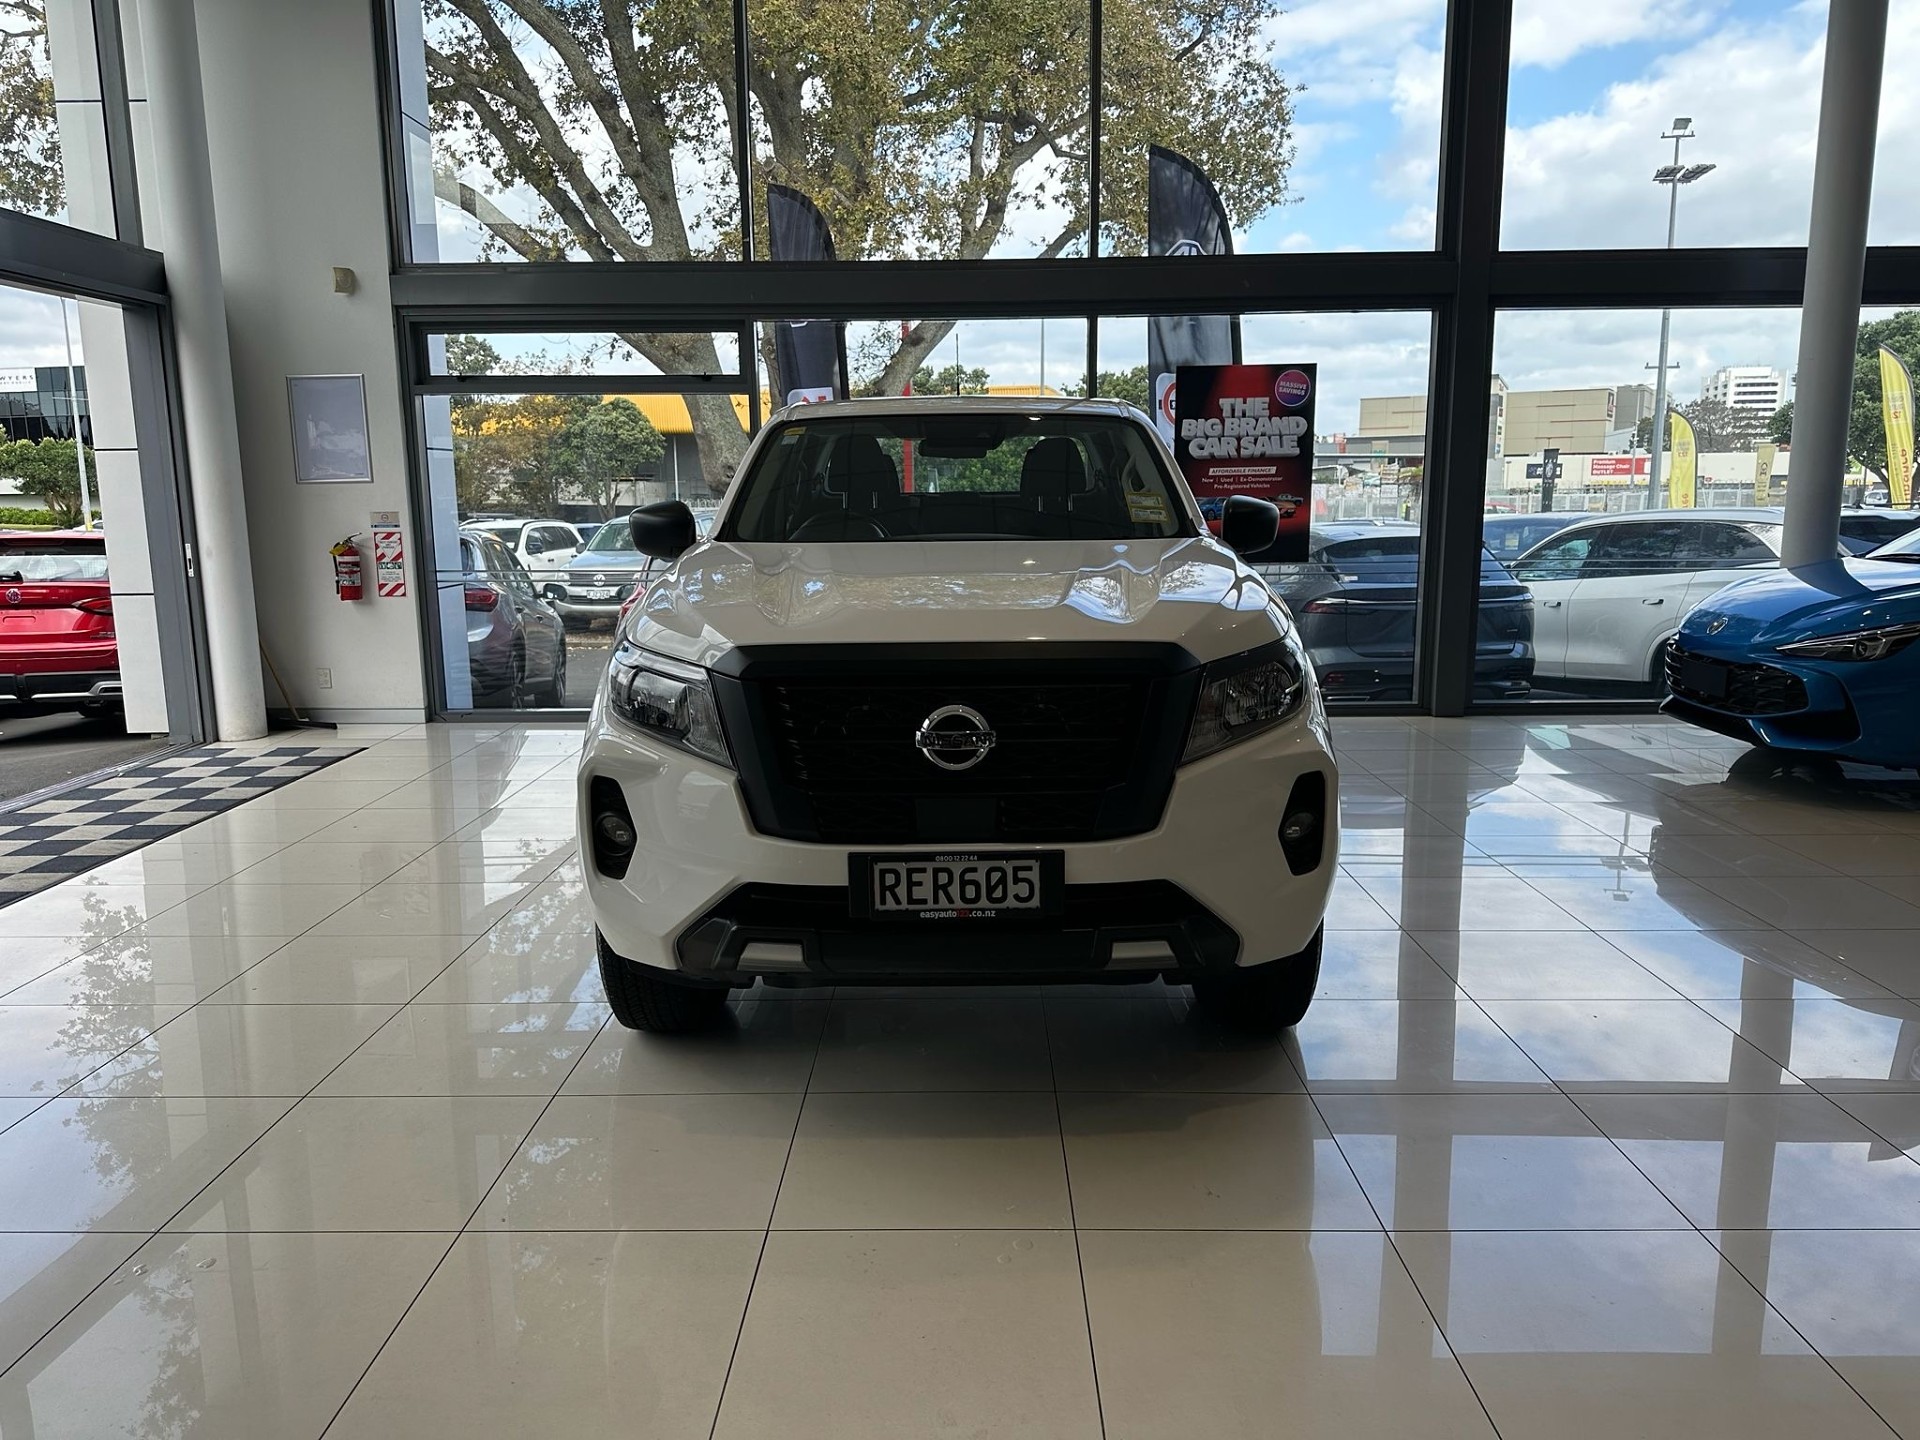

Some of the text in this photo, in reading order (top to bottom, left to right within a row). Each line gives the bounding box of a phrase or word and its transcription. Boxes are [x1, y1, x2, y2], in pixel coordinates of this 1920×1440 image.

[1279, 387, 1305, 396] SAVINGS
[1280, 381, 1307, 390] MASSIVE
[1219, 397, 1270, 418] THE
[1181, 416, 1308, 440] BIG BRAND
[1188, 435, 1300, 460] CAR SALE
[922, 732, 993, 748] NISSAN
[878, 865, 1036, 906] RER605
